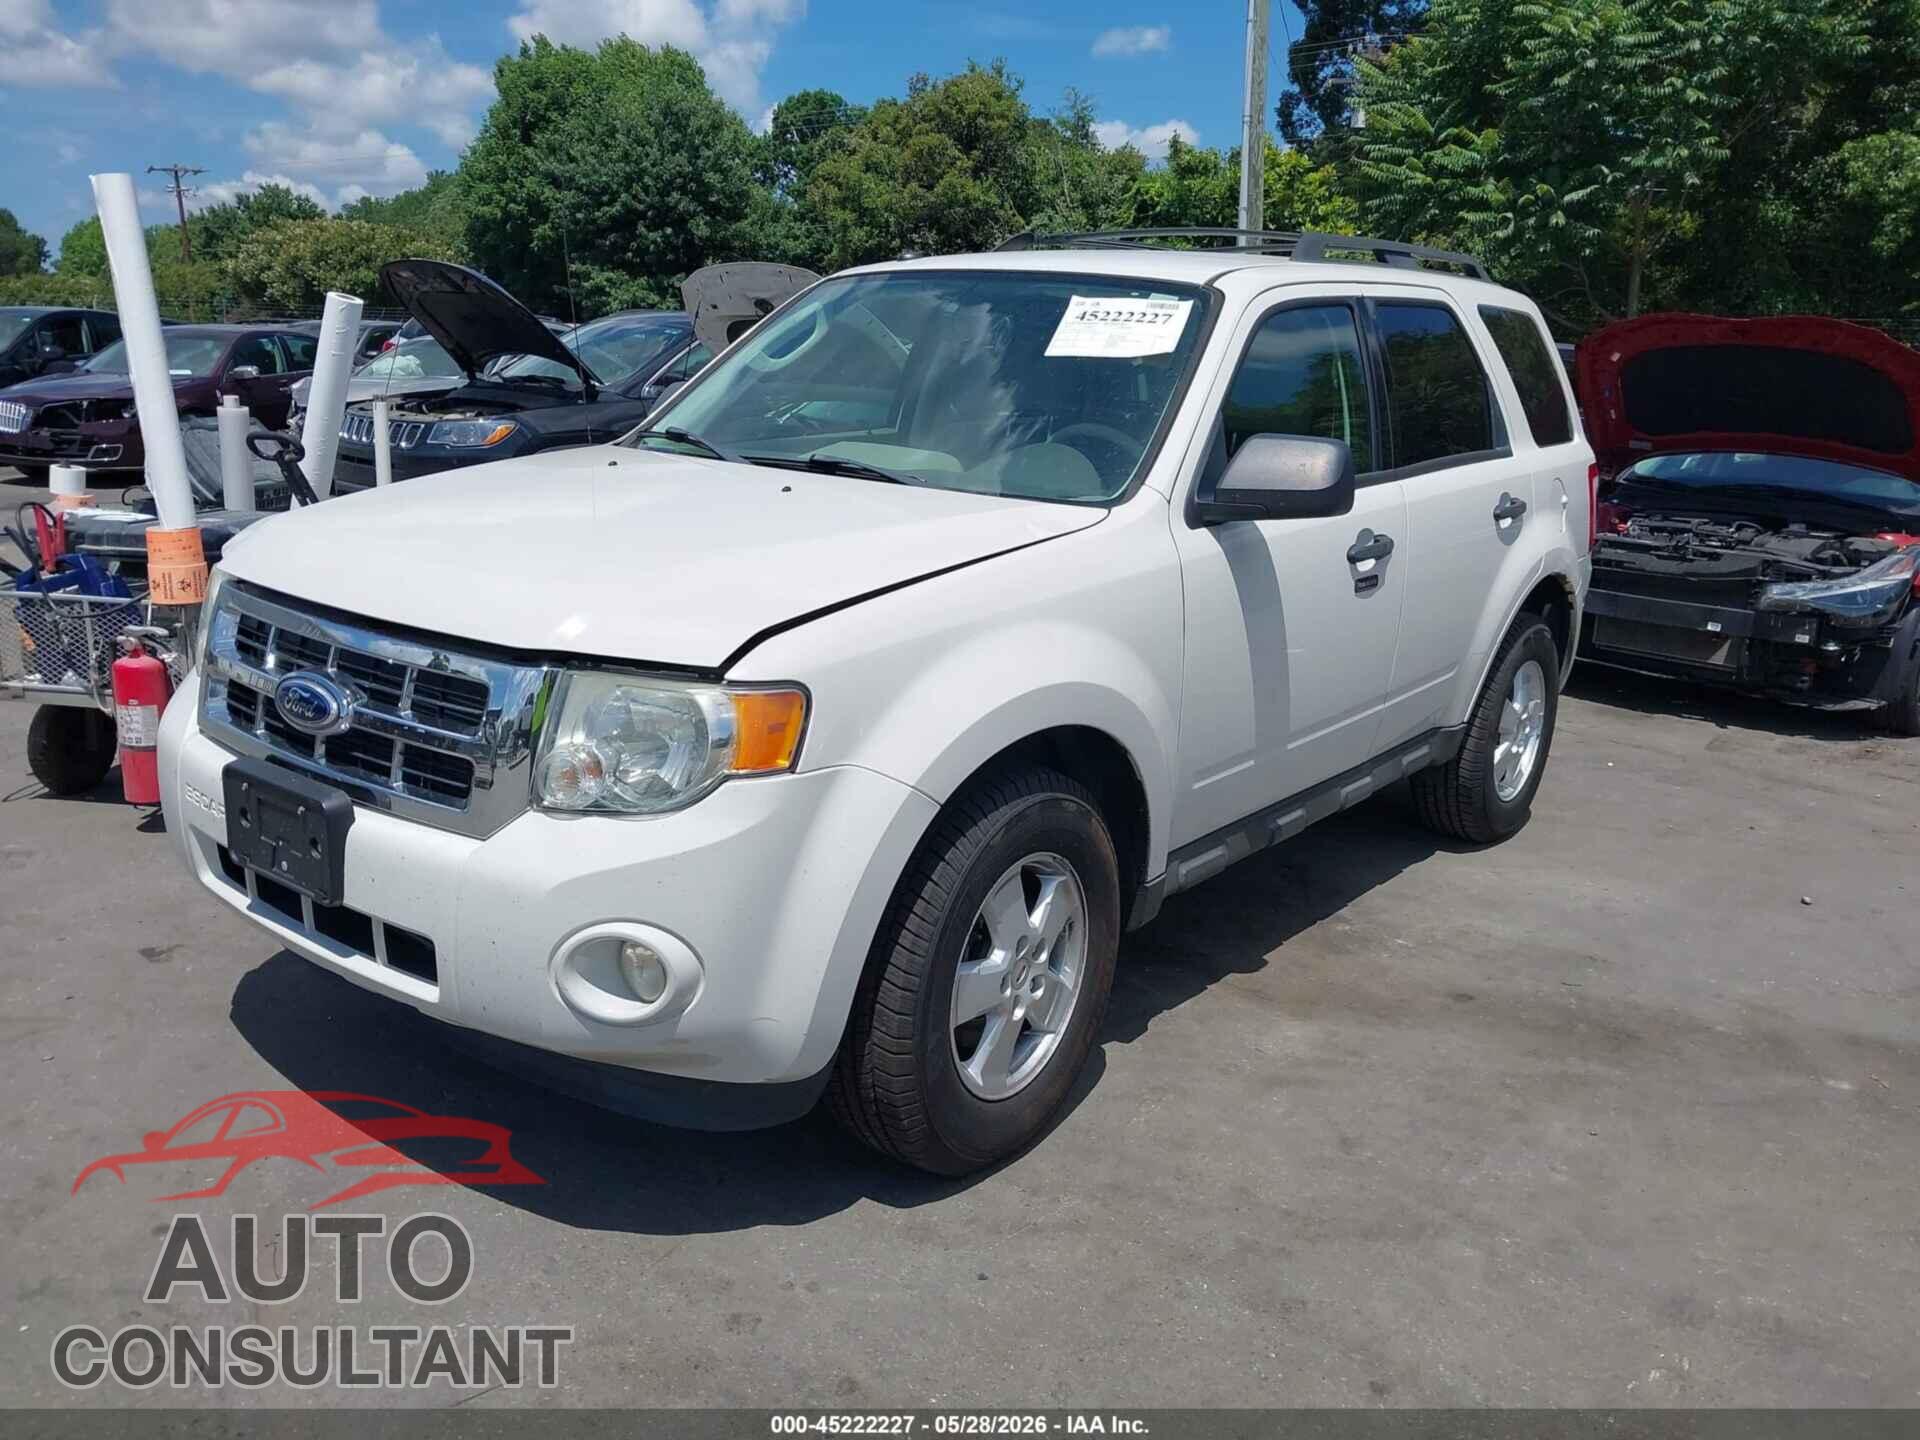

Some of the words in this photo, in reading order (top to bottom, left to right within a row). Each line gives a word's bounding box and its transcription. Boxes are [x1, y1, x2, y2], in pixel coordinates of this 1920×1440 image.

[1075, 310, 1174, 325] 45222227
[284, 687, 319, 718] Ford
[184, 782, 225, 818] ESCAP
